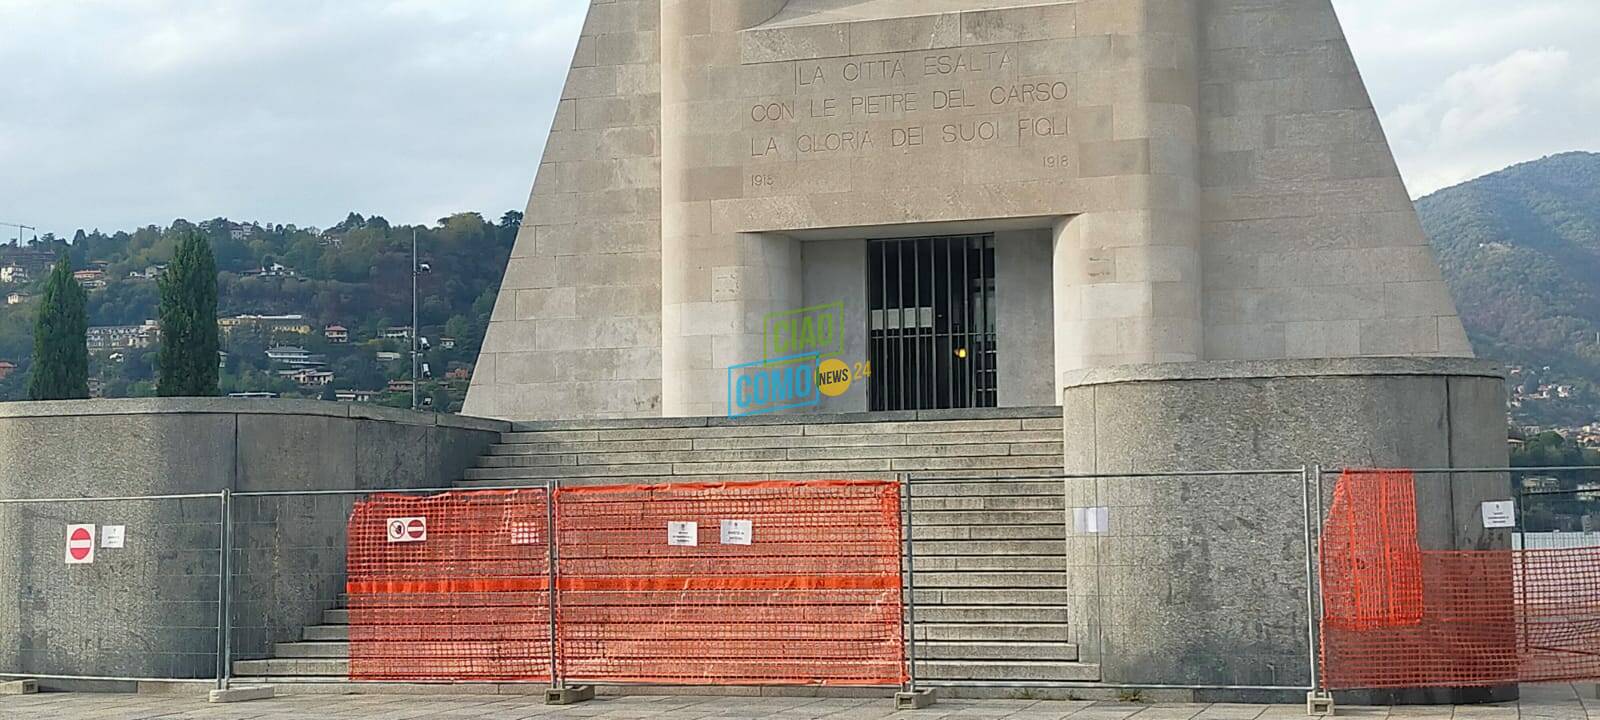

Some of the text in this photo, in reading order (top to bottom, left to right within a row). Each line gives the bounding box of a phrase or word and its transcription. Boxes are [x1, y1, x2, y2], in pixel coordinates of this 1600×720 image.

[799, 66, 826, 86] LA
[924, 51, 1013, 76] ESALTA
[751, 81, 1068, 122] CON LE PIETRE DEL CARSO
[751, 115, 1069, 157] LA GLORIA DEI SUOI FIGLI
[1042, 154, 1069, 168] 1918
